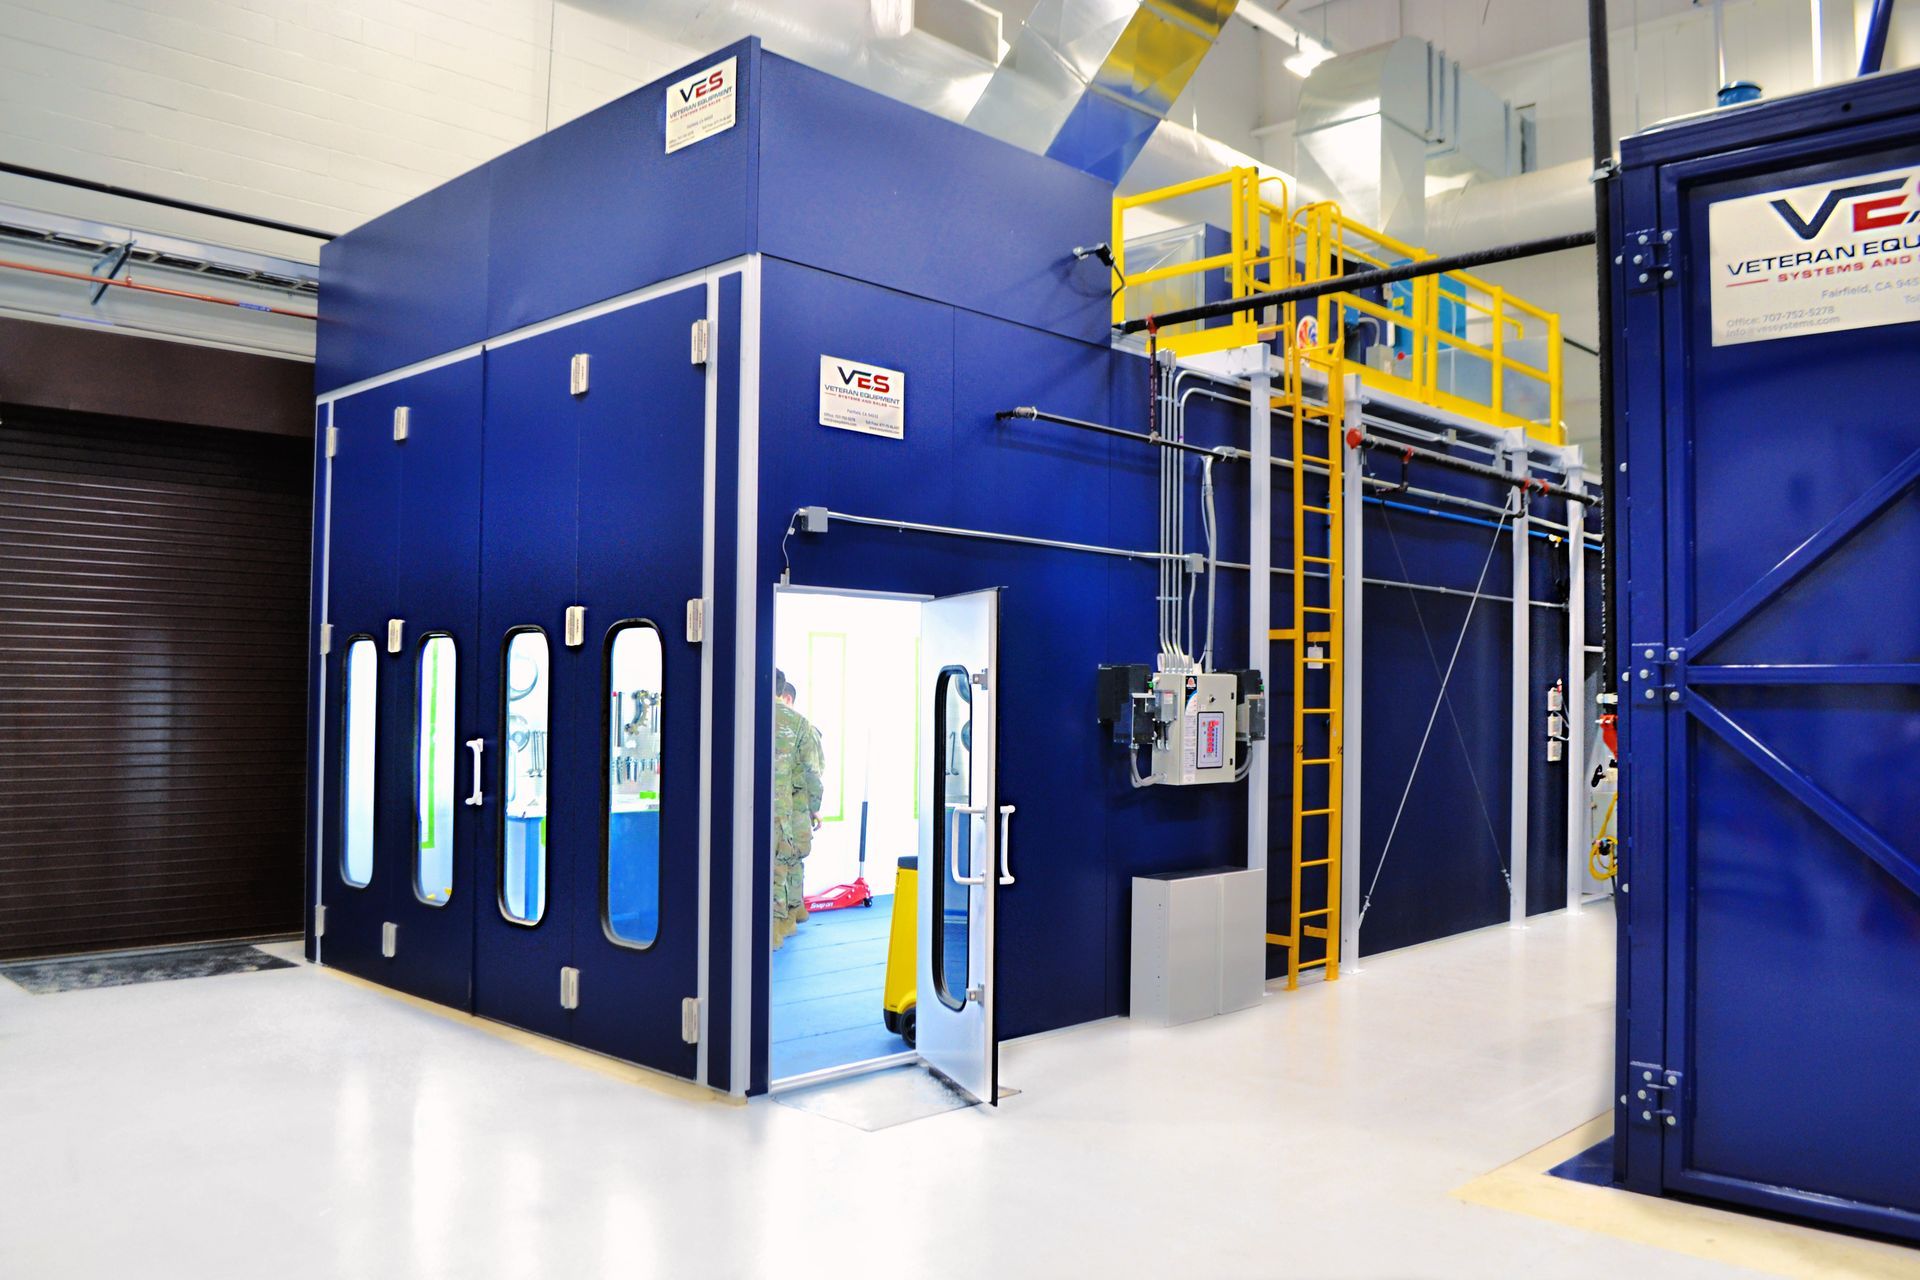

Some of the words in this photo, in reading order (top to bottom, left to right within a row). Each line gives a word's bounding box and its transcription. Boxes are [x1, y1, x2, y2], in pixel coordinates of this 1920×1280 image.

[680, 70, 723, 103] VES
[670, 103, 697, 119] VETERAN
[697, 86, 733, 107] EQUIPMENT
[1769, 175, 1920, 241] VE
[1727, 244, 1855, 276] VETERAN
[1777, 262, 1865, 283] SYSTEMS
[1871, 254, 1912, 269] AND
[1820, 284, 1872, 301] Fairfield,
[1874, 281, 1893, 293] CA
[1762, 306, 1836, 323] 707-752-5278
[824, 384, 859, 397] VETERAN
[859, 391, 900, 405] EQUIPMENT
[837, 366, 890, 394] VES
